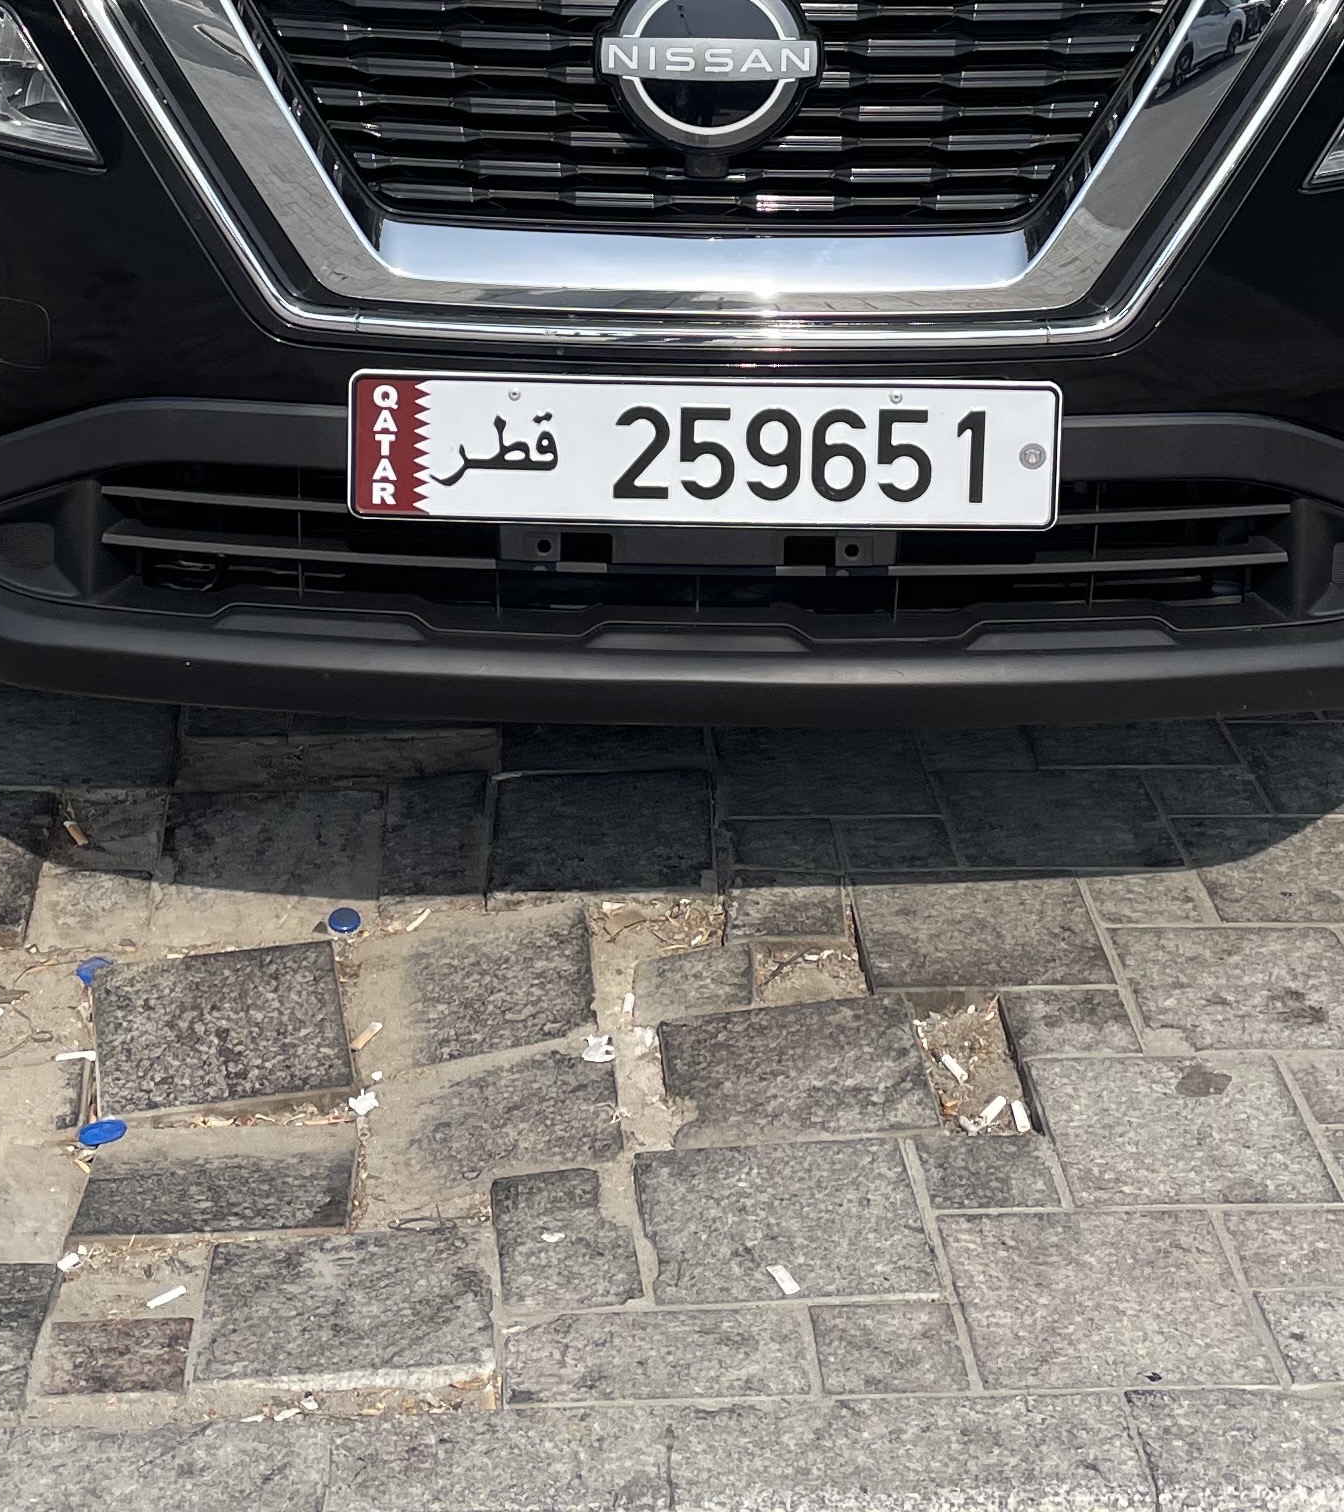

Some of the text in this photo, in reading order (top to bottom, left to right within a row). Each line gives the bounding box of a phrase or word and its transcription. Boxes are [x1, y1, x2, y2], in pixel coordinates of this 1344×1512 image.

[608, 44, 810, 72] NISSAN
[372, 384, 397, 505] QATAR
[429, 411, 558, 486] قطر
[612, 406, 988, 504] 259651
